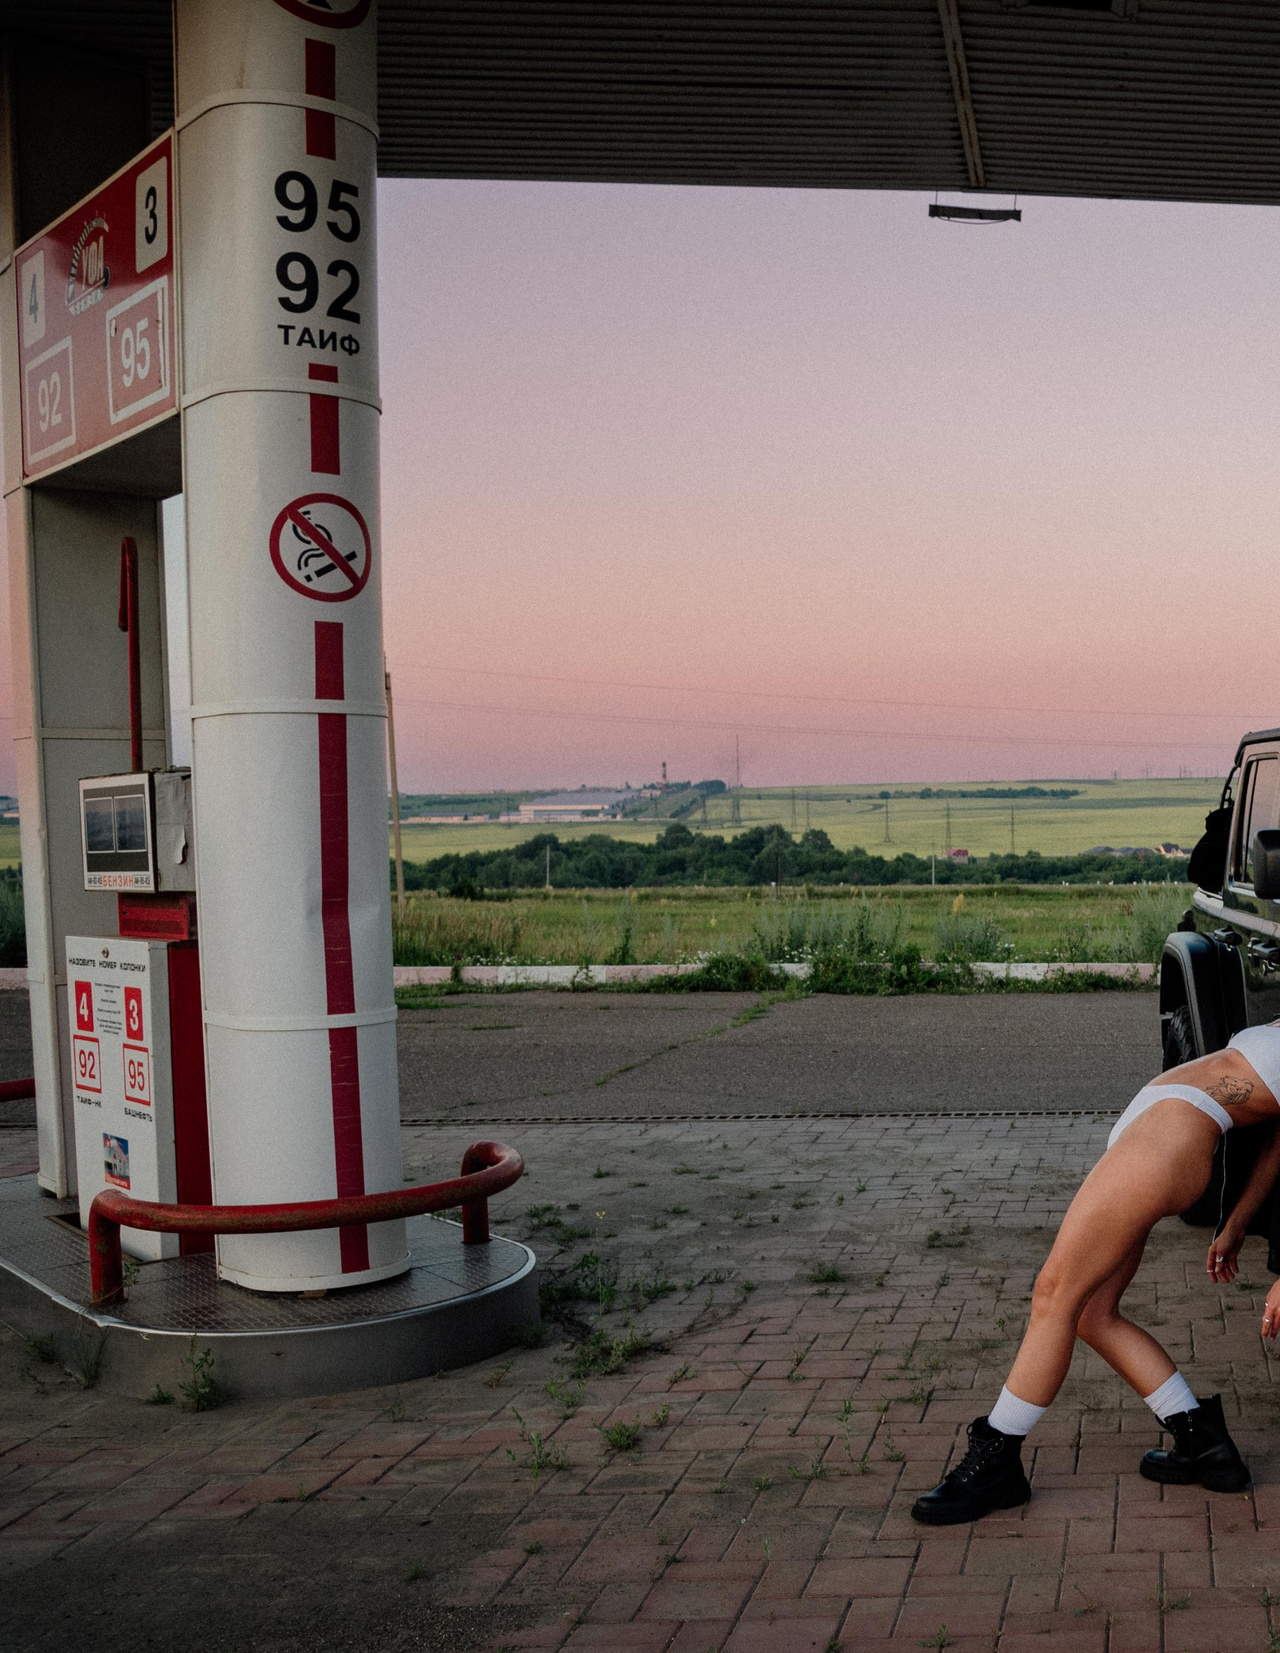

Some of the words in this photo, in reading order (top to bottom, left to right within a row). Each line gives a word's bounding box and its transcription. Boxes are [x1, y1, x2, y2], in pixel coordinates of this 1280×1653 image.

[144, 186, 158, 245] 3
[274, 170, 361, 243] 95
[29, 273, 39, 324] 4
[275, 252, 361, 325] 92
[121, 317, 151, 388] 95
[277, 324, 361, 357] ТАИФ
[38, 371, 62, 433] 92
[102, 875, 134, 887] БЕНЗИН
[79, 991, 89, 1021] 4
[129, 998, 139, 1031] 3
[78, 1050, 96, 1080] 92
[128, 1061, 146, 1092] 95
